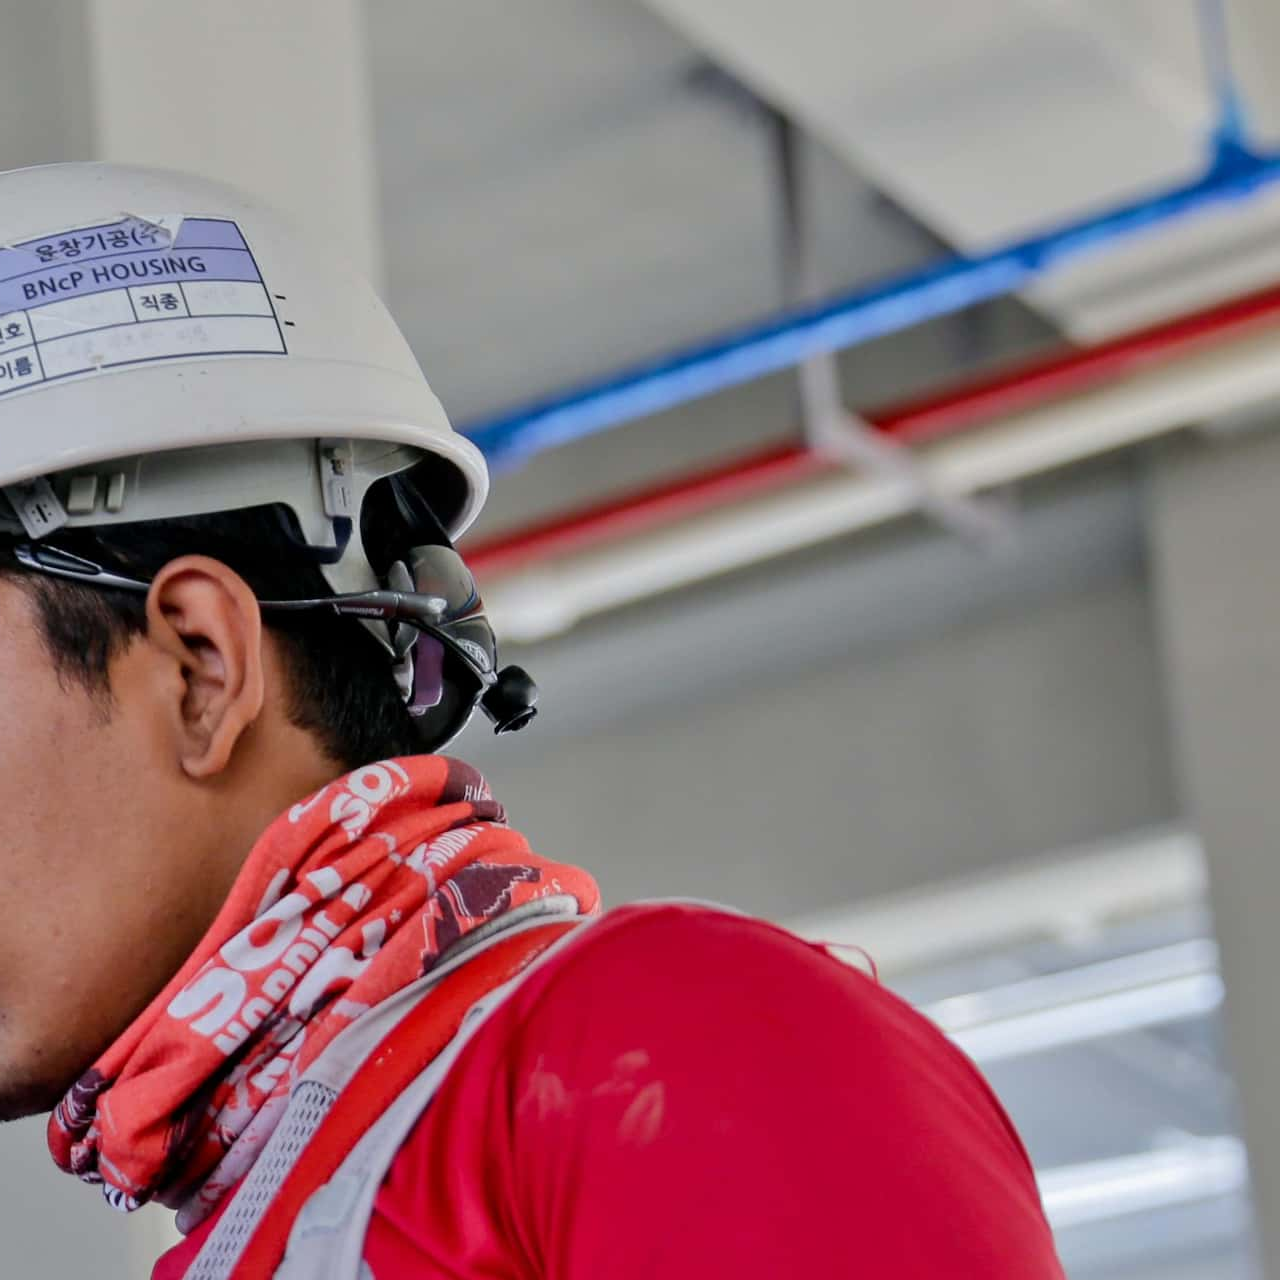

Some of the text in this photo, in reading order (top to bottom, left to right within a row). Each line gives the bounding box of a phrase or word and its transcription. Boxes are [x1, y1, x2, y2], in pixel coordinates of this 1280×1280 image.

[22, 256, 207, 301] BNcP HOUSING
[141, 292, 179, 313] 직종
